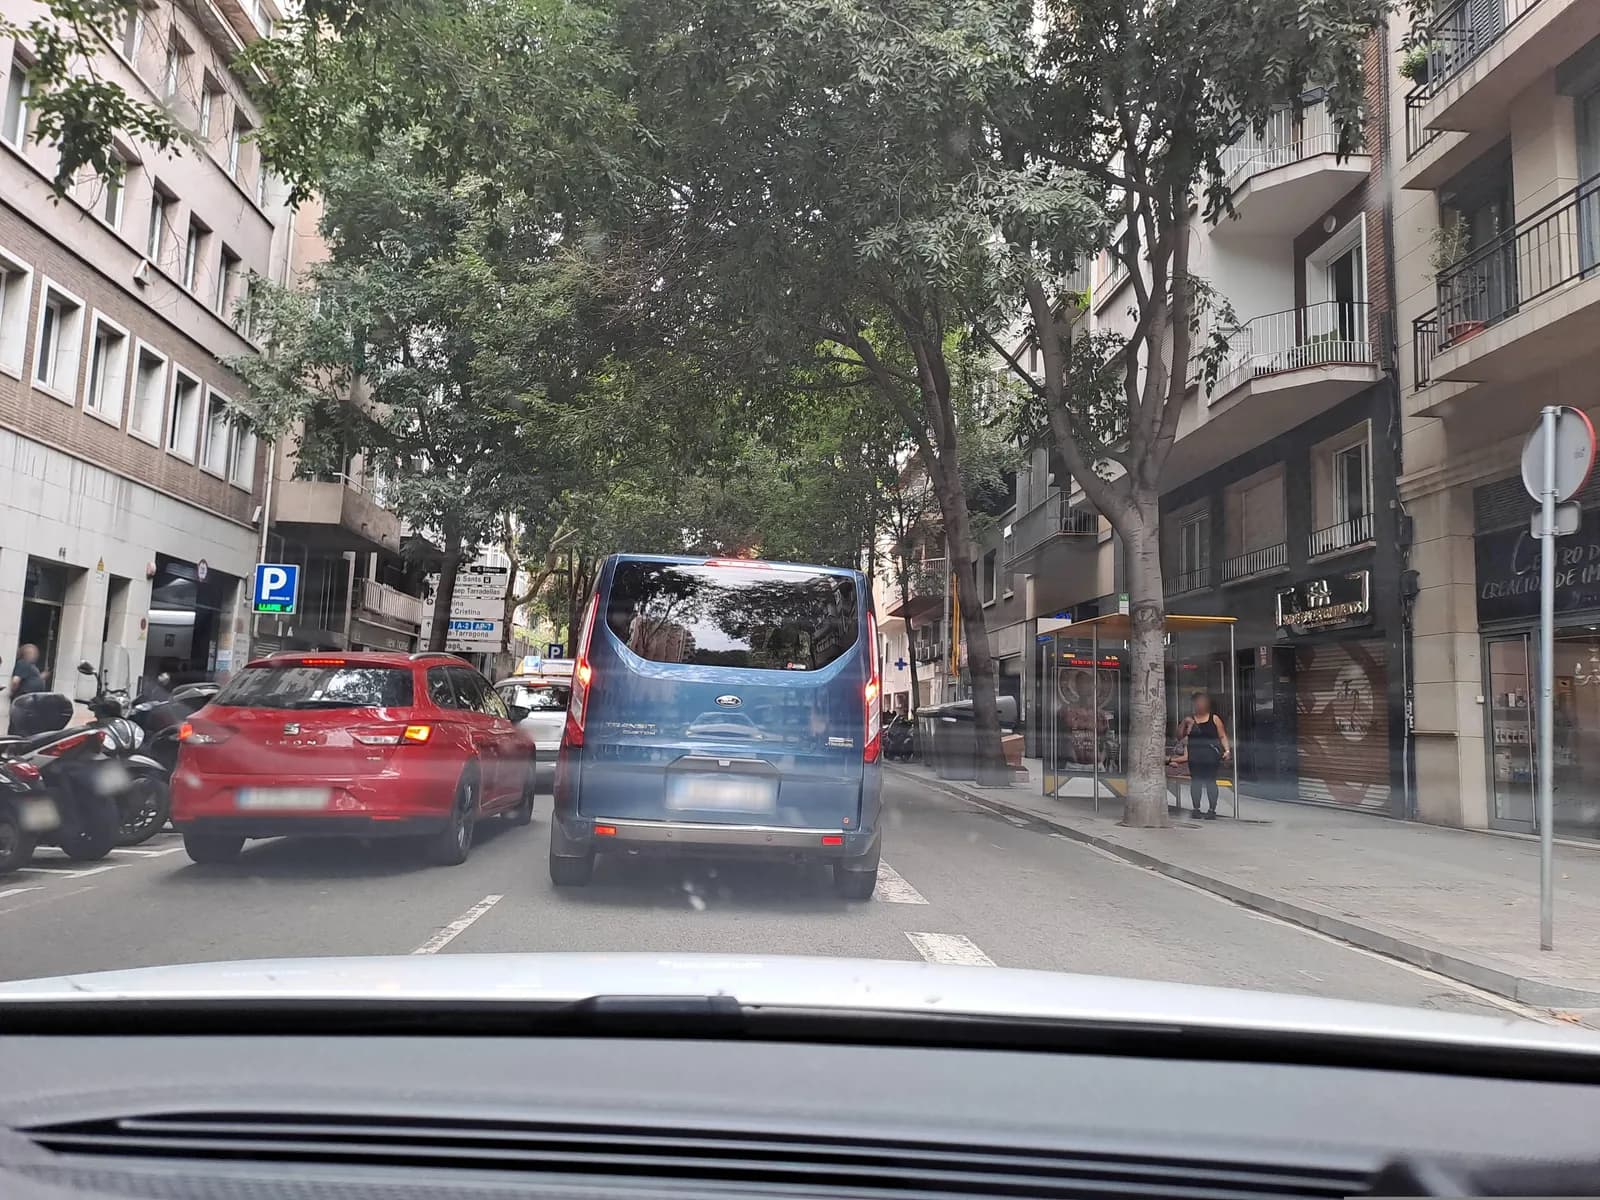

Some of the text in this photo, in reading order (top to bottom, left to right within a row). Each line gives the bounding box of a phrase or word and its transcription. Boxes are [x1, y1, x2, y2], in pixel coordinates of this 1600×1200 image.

[261, 567, 287, 600] P
[1481, 575, 1542, 600] CREACIO
[1555, 568, 1577, 589] DE
[467, 587, 500, 595] Tarradellas
[454, 608, 481, 616] Cristina
[447, 630, 488, 638] a-Tarragona
[551, 647, 561, 659] P
